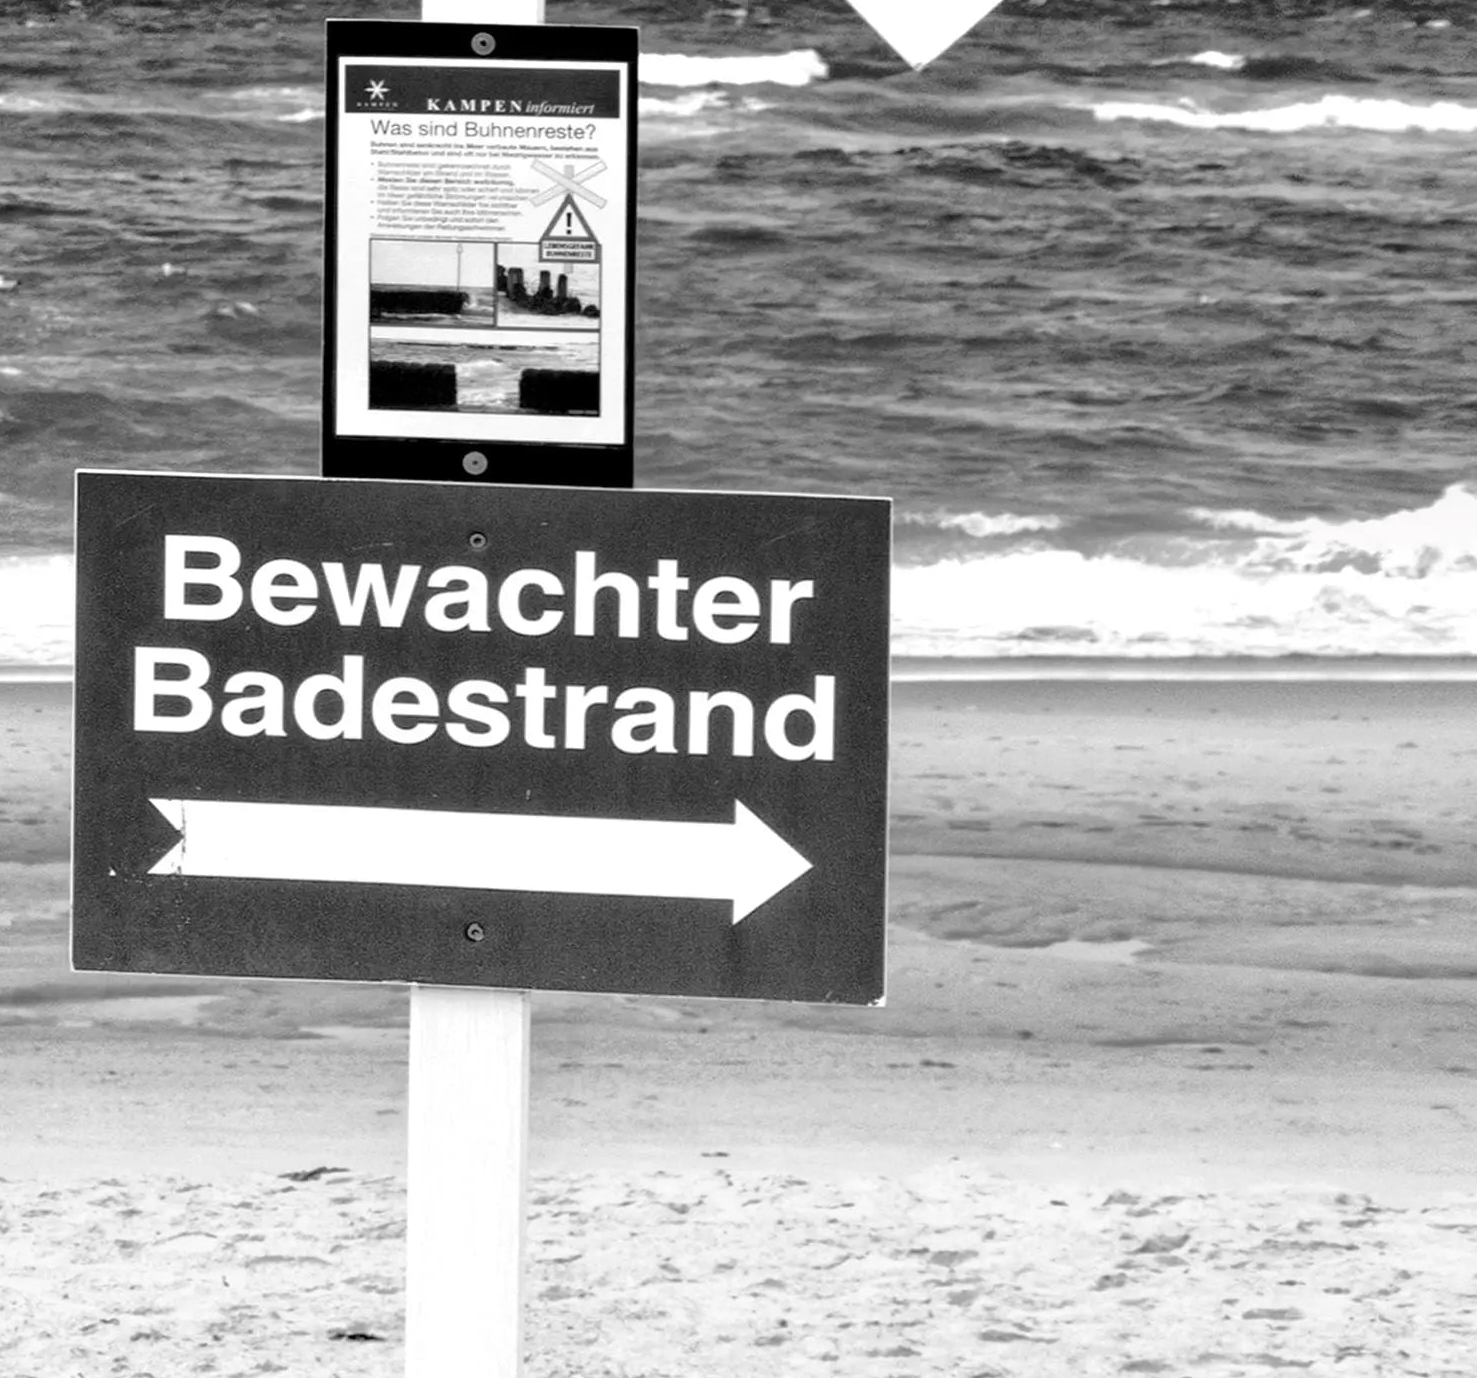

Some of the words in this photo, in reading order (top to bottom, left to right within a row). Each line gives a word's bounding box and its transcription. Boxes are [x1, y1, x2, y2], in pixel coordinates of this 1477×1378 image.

[370, 119, 413, 136] Was
[418, 120, 458, 137] sind
[464, 121, 597, 140] Buhnenreste?
[427, 98, 523, 114] KAMPEN
[525, 101, 595, 116] informiert
[163, 533, 815, 645] Bewachter
[133, 644, 836, 763] Badestrand
